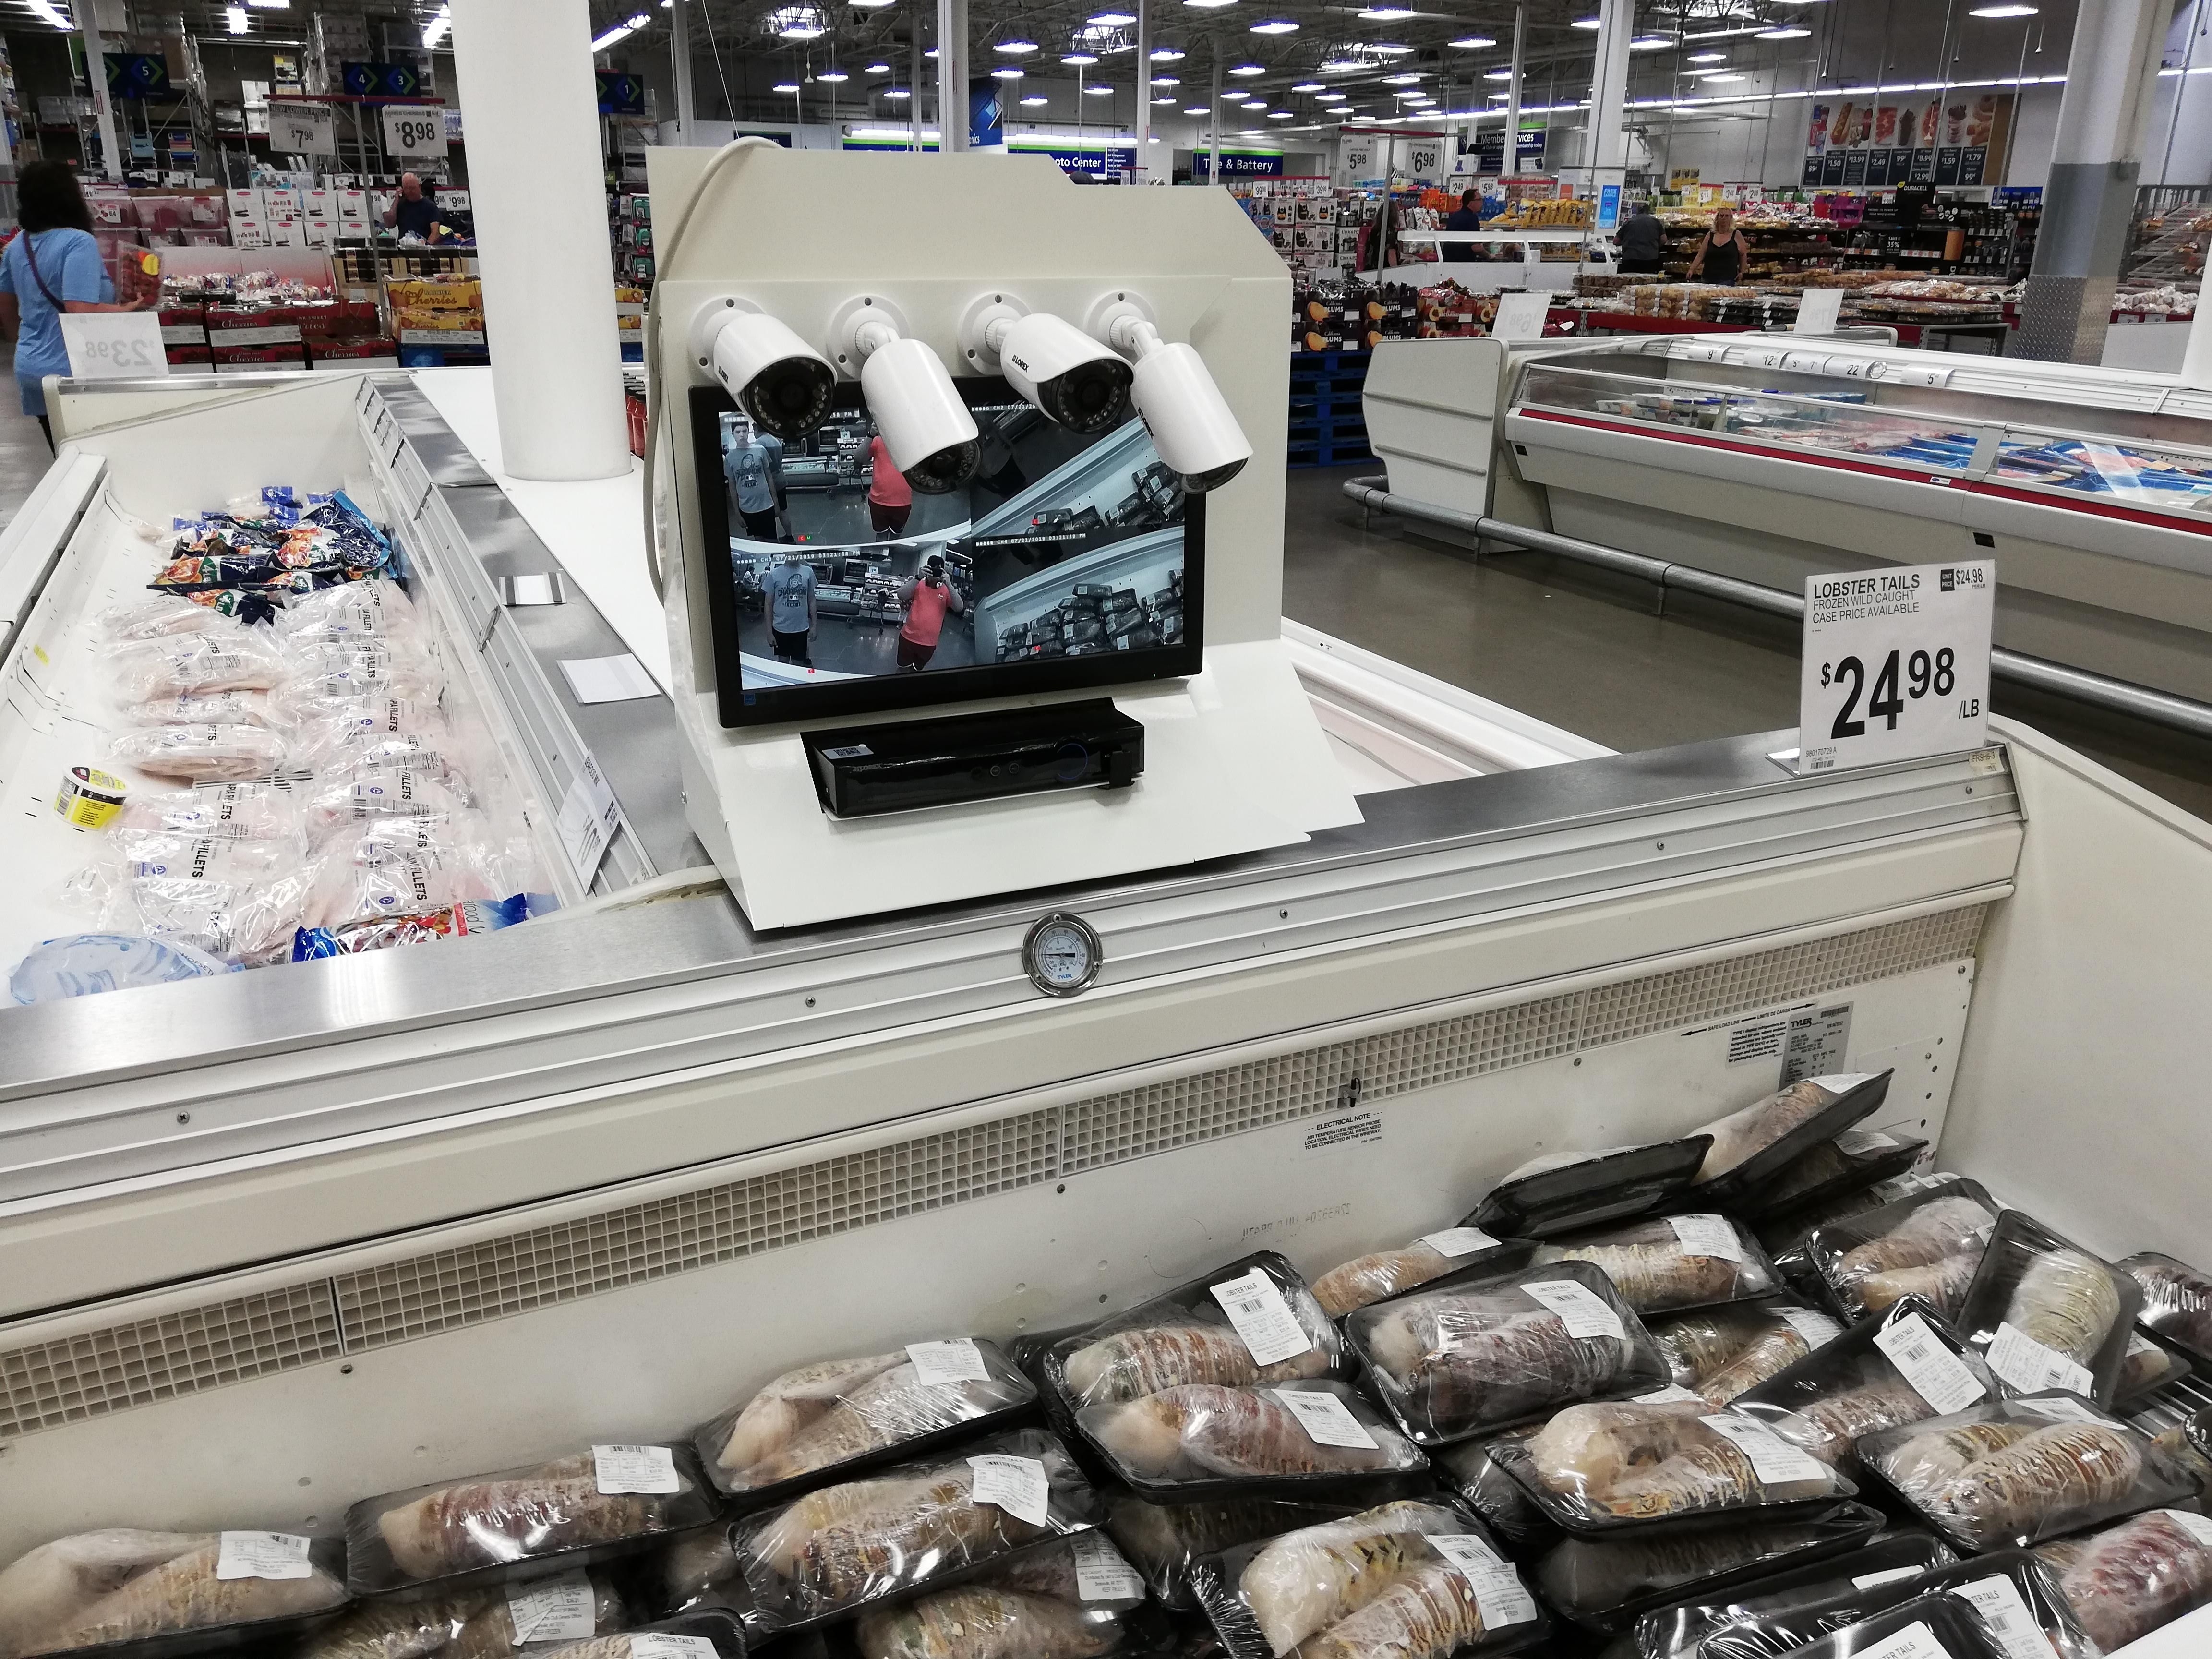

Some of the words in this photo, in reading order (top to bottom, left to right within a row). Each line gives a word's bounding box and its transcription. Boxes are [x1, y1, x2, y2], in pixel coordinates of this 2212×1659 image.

[142, 66, 149, 76] 5
[359, 74, 365, 84] 4
[398, 75, 404, 85] 3
[625, 84, 629, 94] 1
[271, 104, 287, 112] NEW
[309, 108, 328, 117] PRICE
[1481, 133, 1505, 144] Membe
[1517, 133, 1534, 143] rvices
[1072, 157, 1102, 168] Center
[1203, 158, 1223, 169] Te
[1226, 159, 1233, 169] &
[1237, 159, 1273, 173] Battery
[405, 288, 457, 305] Cherries
[229, 351, 265, 362] Cherries
[325, 348, 359, 358] Cherries
[1015, 356, 1029, 373] LOREX
[1956, 568, 1984, 586] $24.98
[1814, 578, 1876, 599] LOBSTER
[1880, 574, 1920, 591] TAILS
[1813, 597, 1849, 611] FROZEN
[1851, 595, 1873, 607] WILD
[1875, 589, 1915, 604] CAUGHT
[1813, 612, 1838, 624] CASE
[1839, 608, 1866, 621] PRICE
[1867, 602, 1920, 618] AVAILABLE
[401, 771, 412, 801] FILLETS
[1791, 1017, 1812, 1028] TYLER
[1316, 1117, 1353, 1130] ELECTRICAL
[1354, 1113, 1371, 1122] NOTE
[1315, 1128, 1347, 1139] TEMPERATURE
[1328, 1130, 1355, 1140] ELECTRICAL
[1319, 1137, 1345, 1147] CONNECTED
[1245, 1282, 1258, 1291] TAILS
[1903, 1326, 1915, 1337] TAILS
[1968, 1594, 1983, 1605] STER
[1983, 1590, 1999, 1600] TAILS
[1895, 1641, 1916, 1655] TAILS
